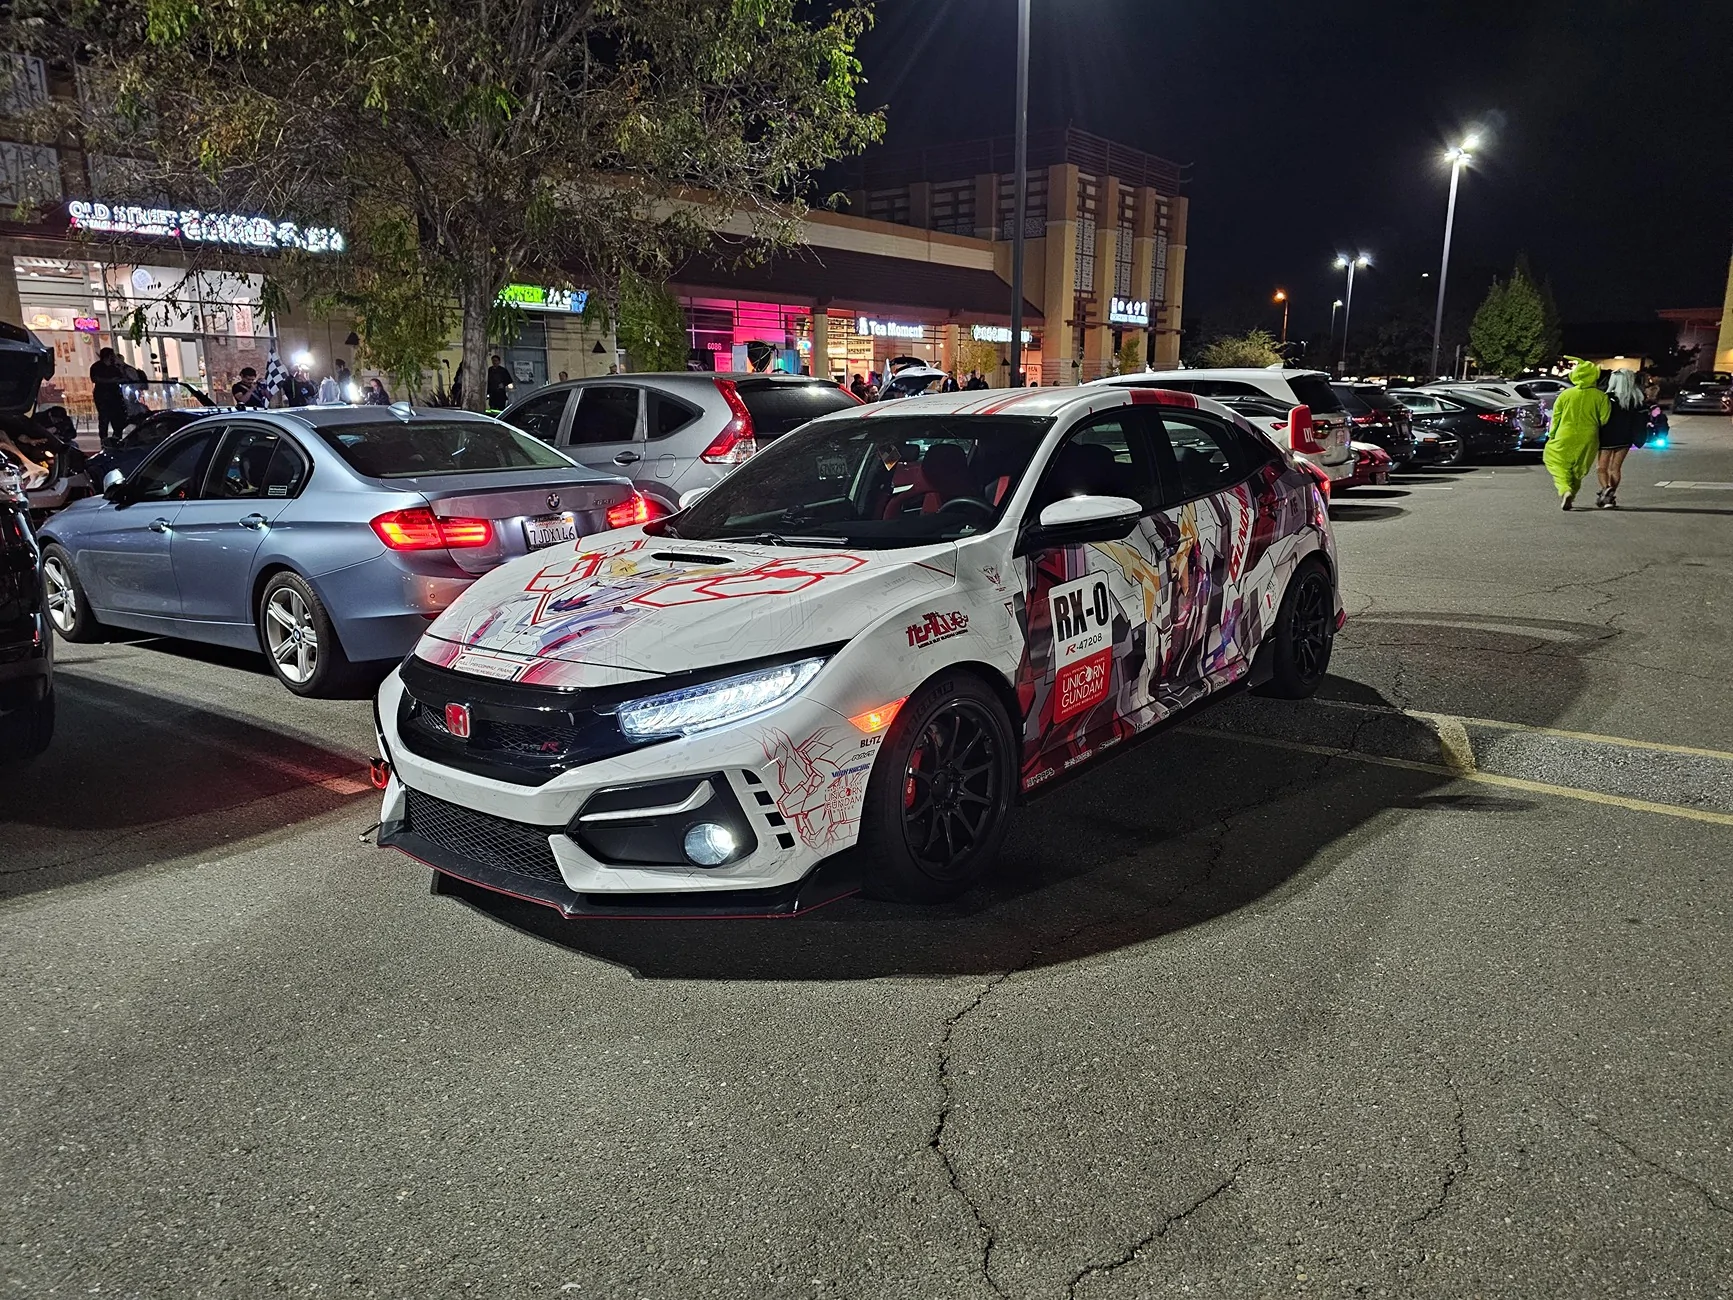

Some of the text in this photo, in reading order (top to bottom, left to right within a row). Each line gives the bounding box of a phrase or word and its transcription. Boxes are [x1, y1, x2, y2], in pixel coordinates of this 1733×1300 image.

[69, 200, 178, 225] OLD STREET
[870, 321, 924, 339] Tea Moment
[530, 526, 576, 544] 7JDX146
[1053, 581, 1109, 642] RX-0
[1061, 678, 1103, 708] GUNDAM
[824, 795, 862, 811] GUNDAM
